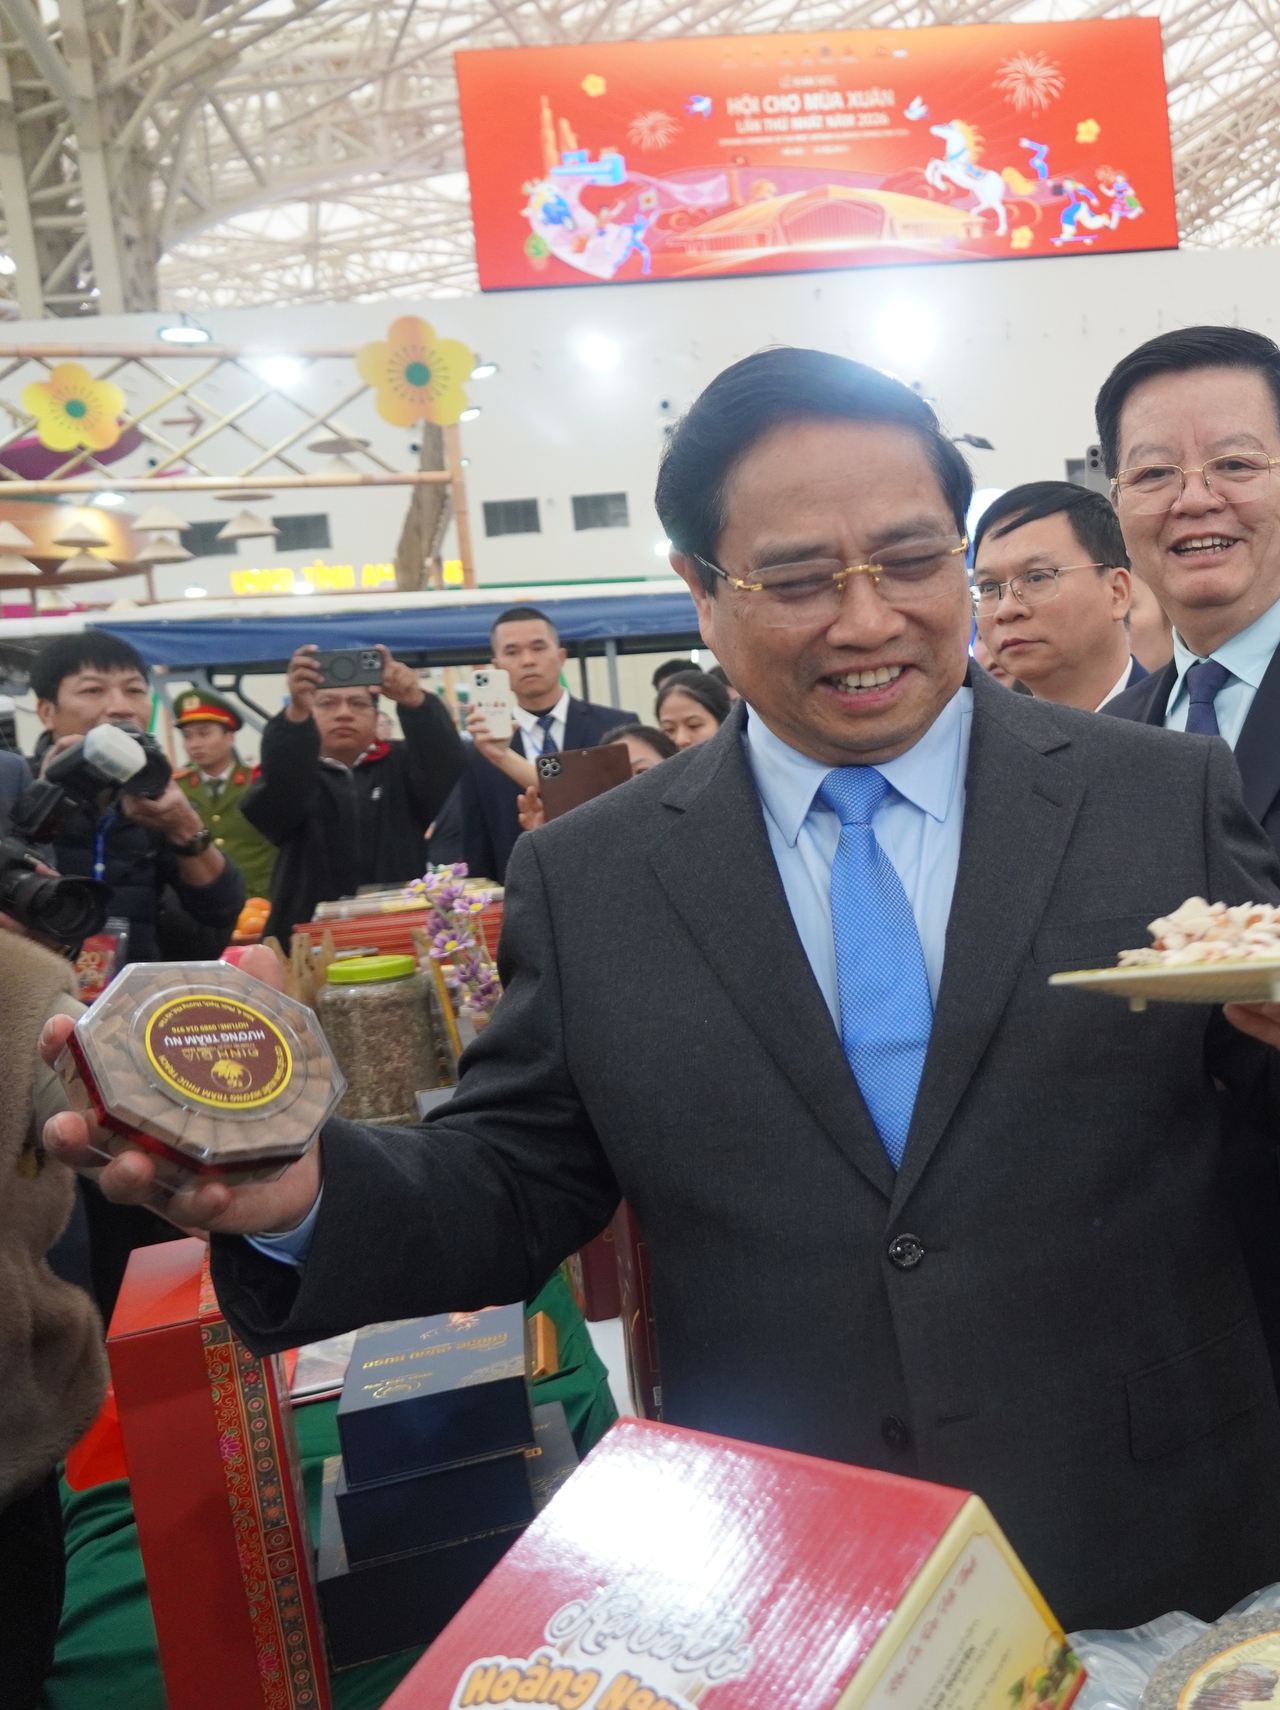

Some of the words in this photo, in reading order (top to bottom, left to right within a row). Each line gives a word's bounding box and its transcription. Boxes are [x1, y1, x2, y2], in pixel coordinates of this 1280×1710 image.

[726, 93, 760, 116] HỘI
[763, 93, 801, 114] CHỢ
[804, 89, 845, 110] MÙA
[846, 86, 895, 108] XUÂN
[171, 1026, 186, 1034] 976
[186, 1025, 199, 1033] 014
[218, 1021, 249, 1031] HOTLINE:
[163, 1034, 183, 1047] NỤ
[184, 1033, 220, 1047] TRẦM
[220, 1029, 266, 1042] HƯƠNG
[458, 1652, 602, 1710] Hoàng
